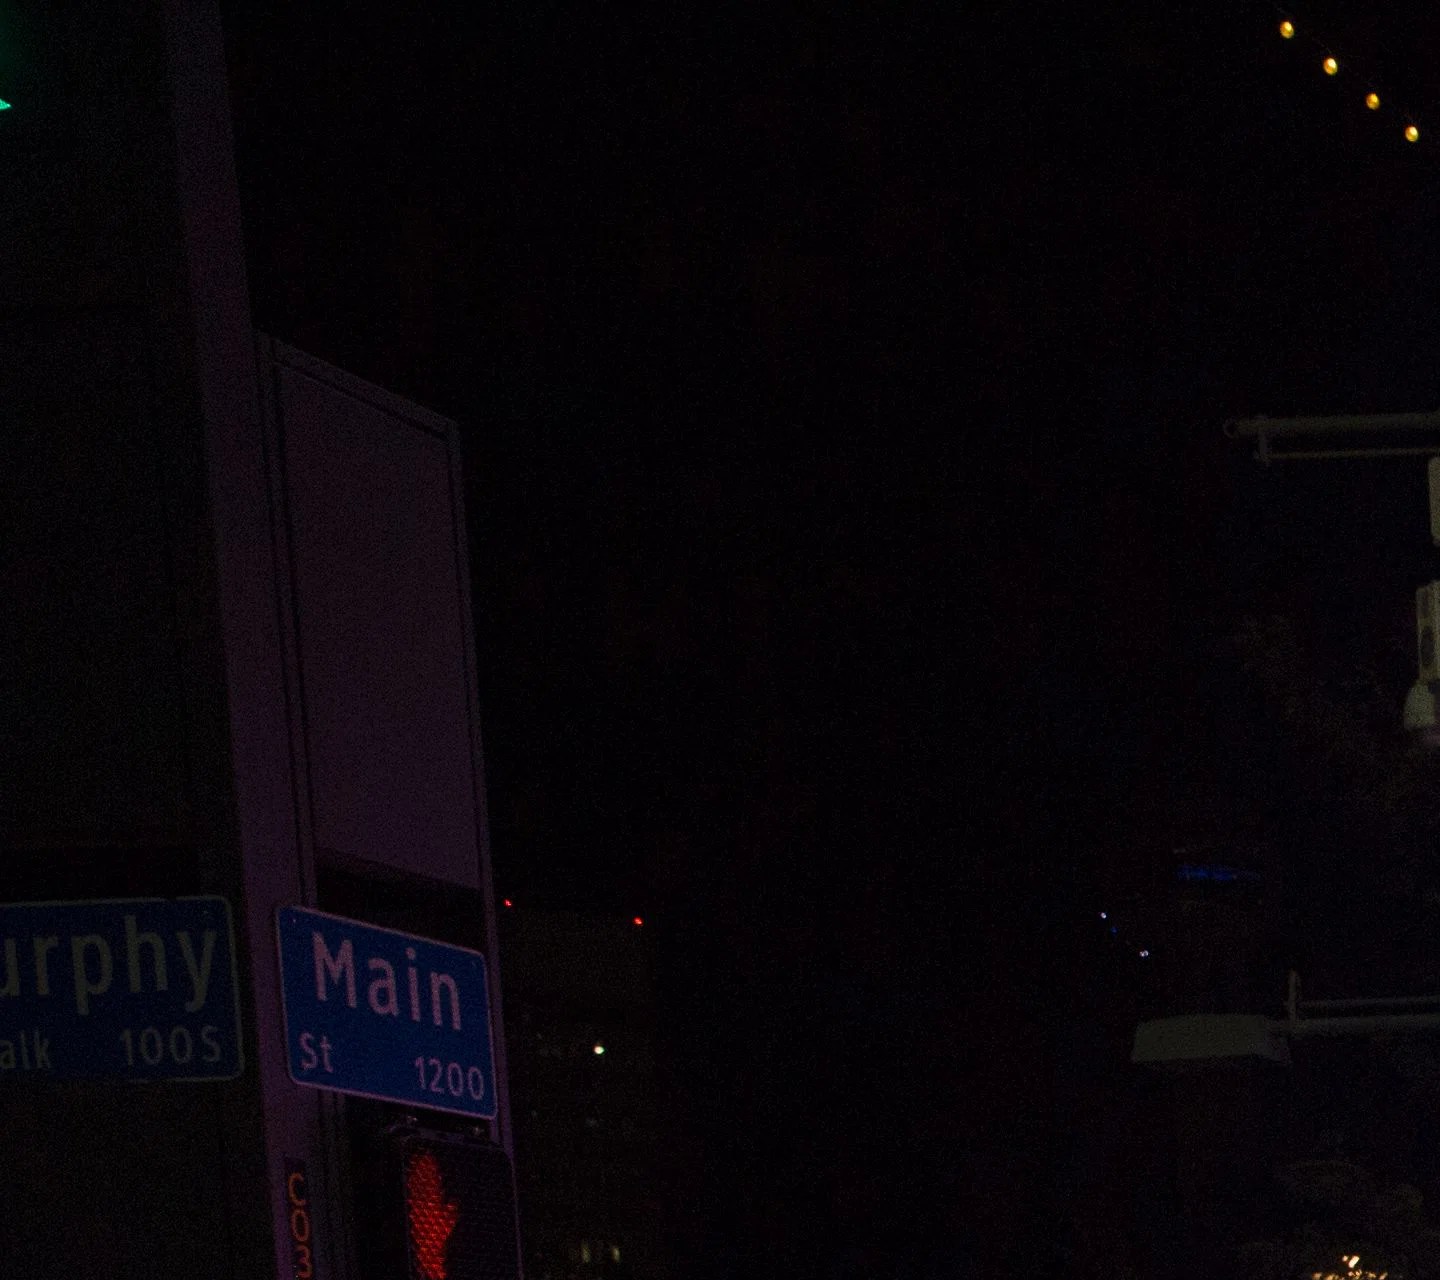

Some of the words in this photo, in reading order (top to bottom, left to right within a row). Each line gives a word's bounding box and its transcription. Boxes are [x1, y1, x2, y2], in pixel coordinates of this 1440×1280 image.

[311, 930, 462, 1032] Main
[119, 1024, 223, 1067] 100S
[300, 1031, 335, 1074] St
[413, 1055, 487, 1101] 1200
